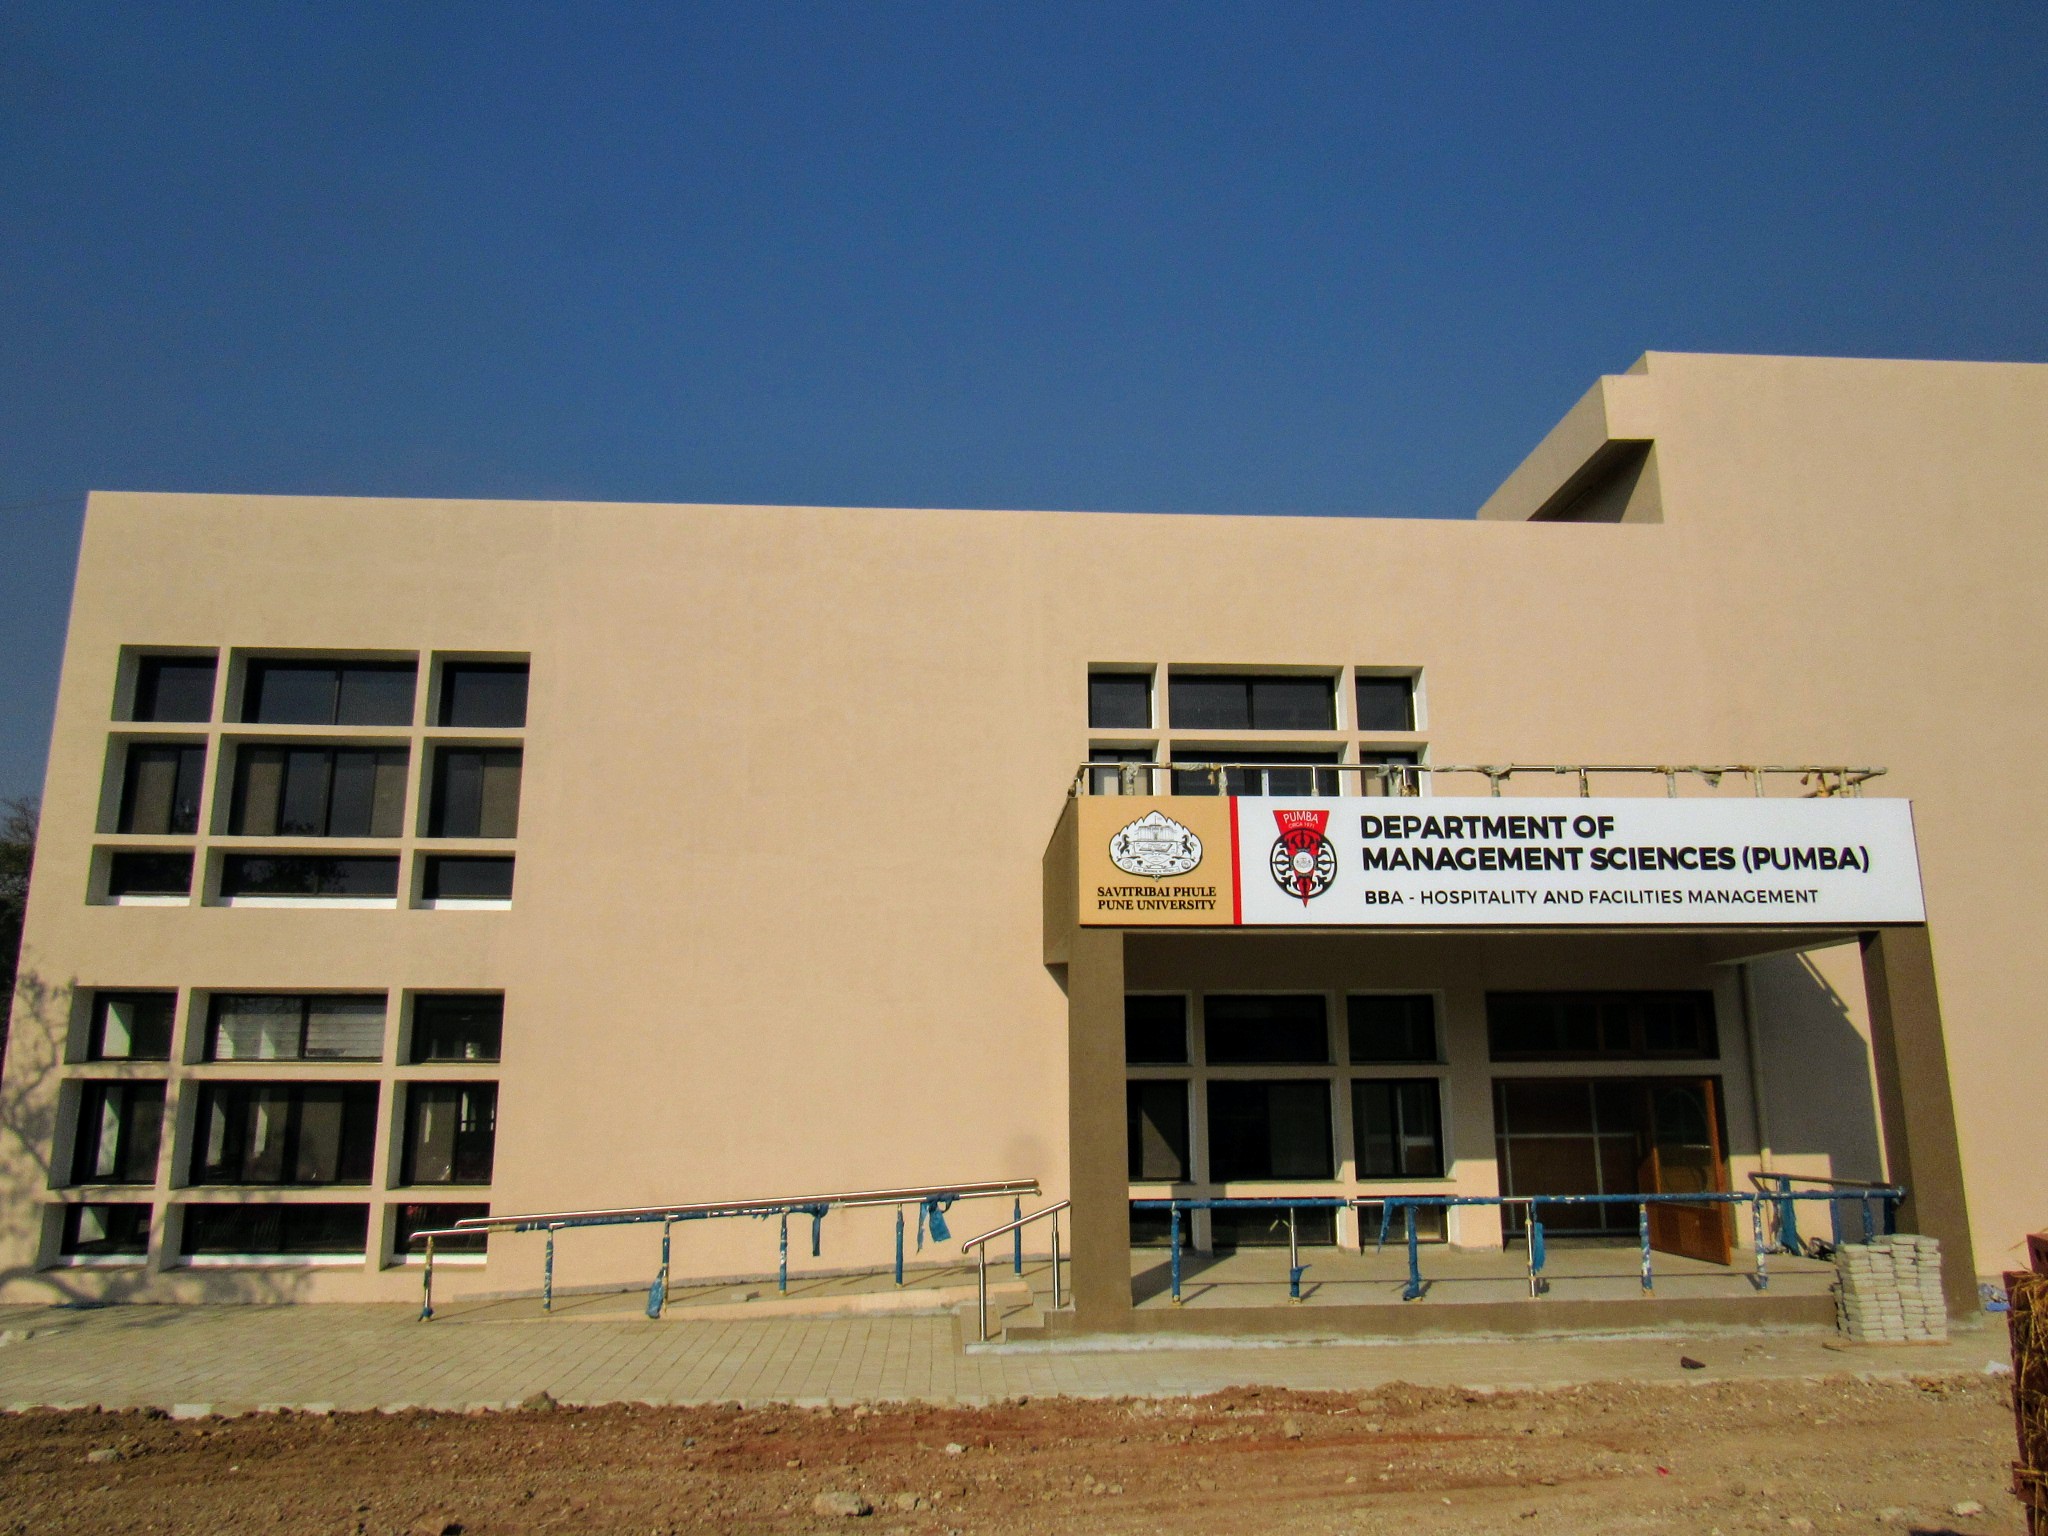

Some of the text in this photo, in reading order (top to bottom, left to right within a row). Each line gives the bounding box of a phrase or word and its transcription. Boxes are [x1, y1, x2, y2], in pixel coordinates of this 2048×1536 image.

[1283, 811, 1319, 824] PUMBA
[1360, 815, 1615, 839] DEPARTMENT OF
[1362, 845, 1870, 873] MANAGEMENT SCIENCES (PUMBA)
[1097, 886, 1217, 897] SAVITRIBAI PHULE
[1364, 890, 1404, 904] BBA
[1420, 890, 1538, 904] HOSPITALITY
[1543, 890, 1584, 904] AND
[1589, 890, 1683, 904] FACILITIES
[1688, 889, 1819, 904] MANAGEMENT
[1097, 899, 1217, 910] PUNE UNIVERSITY
